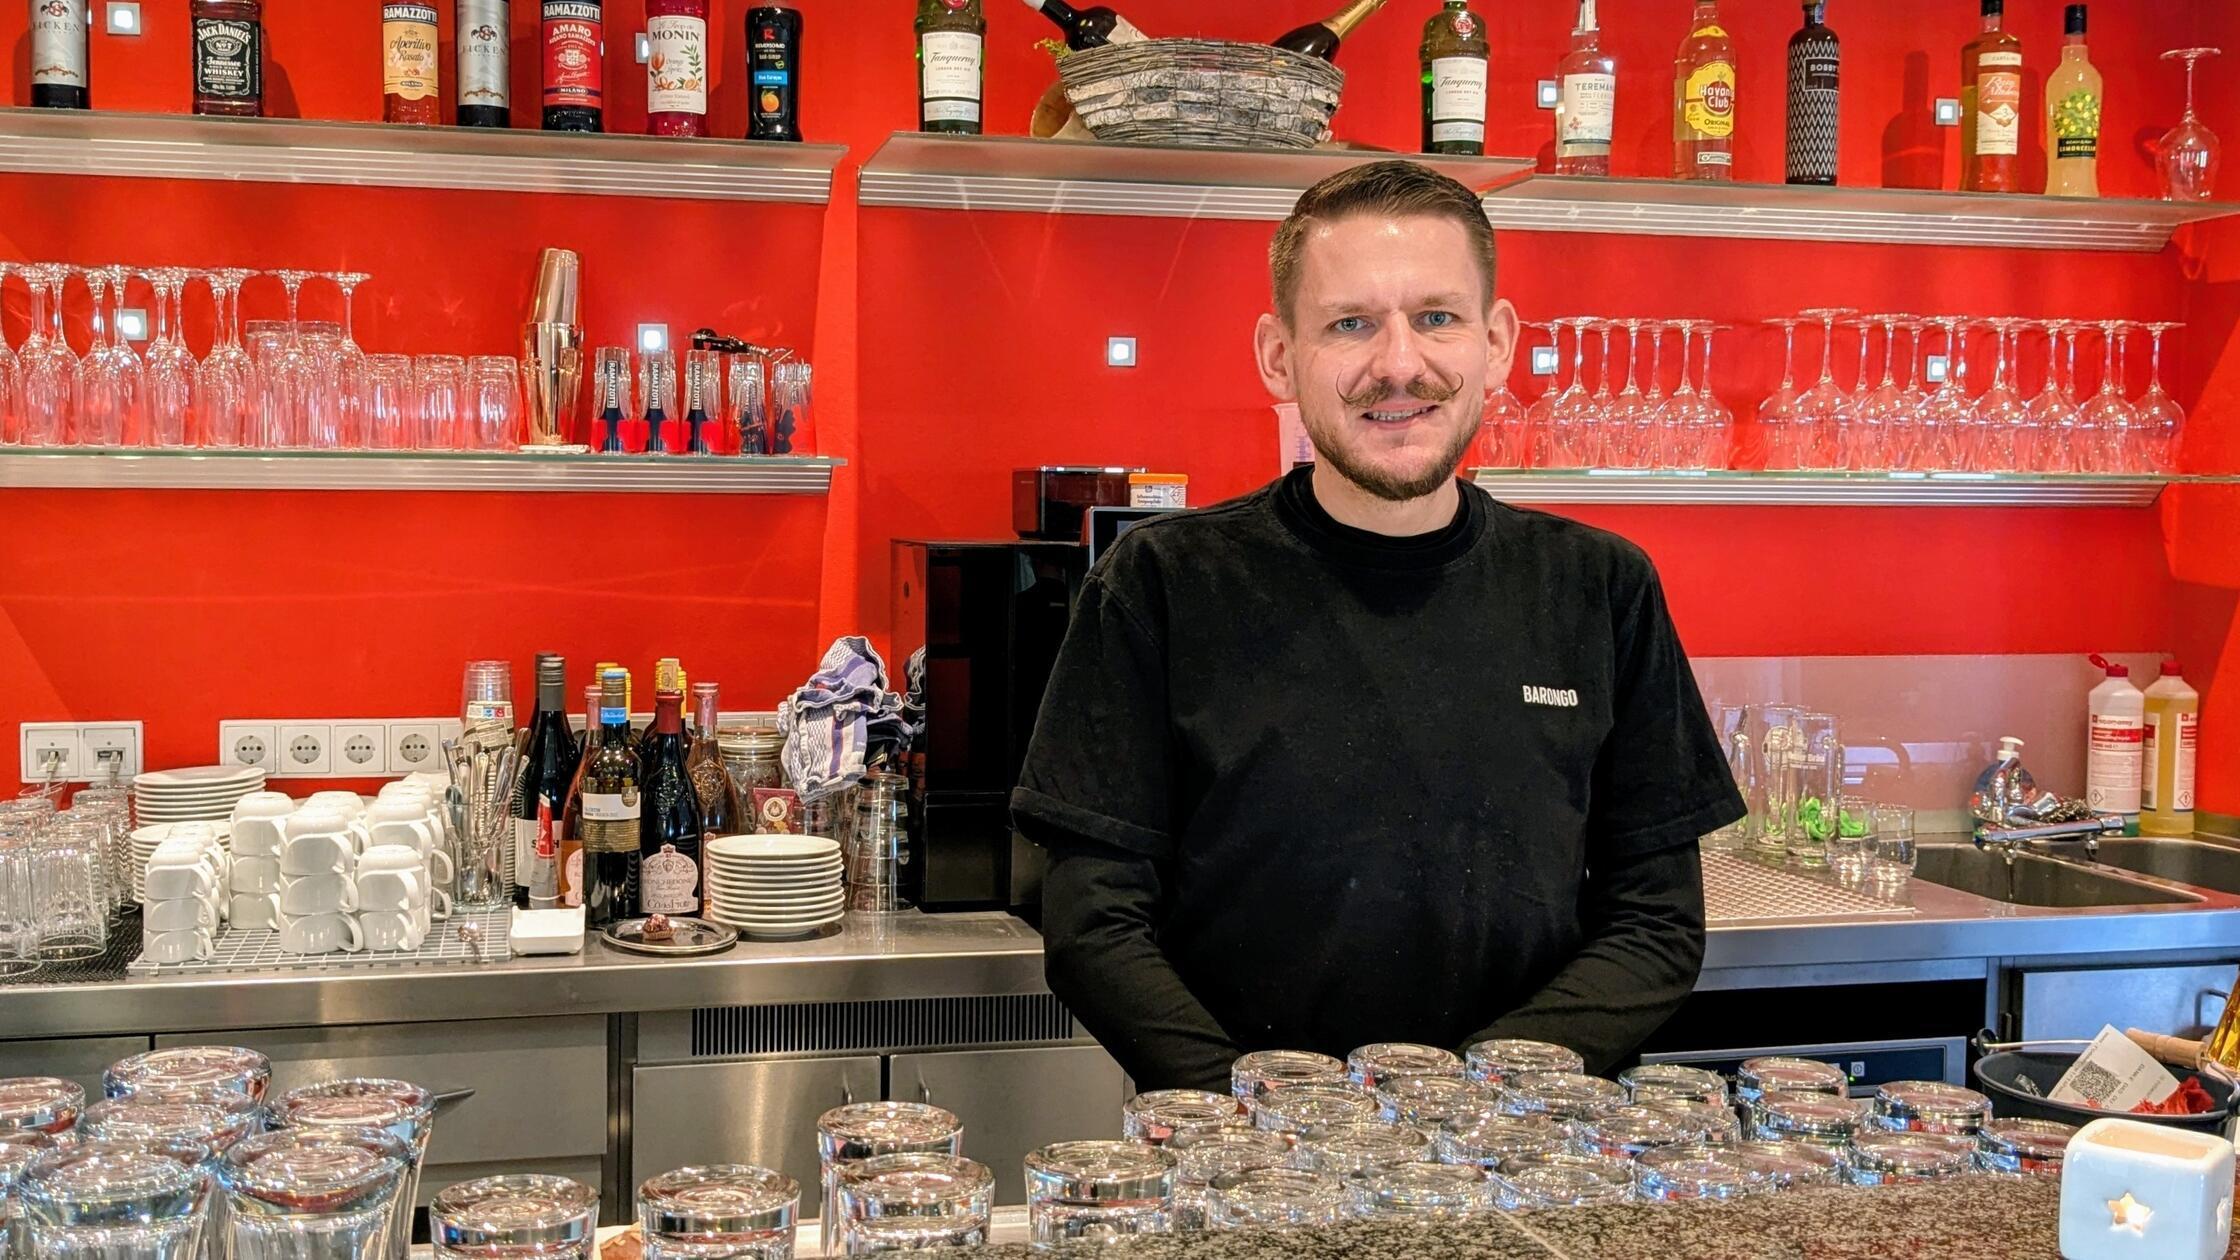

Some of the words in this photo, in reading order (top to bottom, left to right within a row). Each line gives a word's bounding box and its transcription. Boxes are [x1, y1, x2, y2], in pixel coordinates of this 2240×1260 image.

[383, 7, 437, 22] RAMAZZOTTI
[544, 4, 600, 20] RAMAZZOTTI
[197, 25, 218, 41] JACK
[217, 23, 251, 46] DANIEL'S
[553, 24, 592, 37] AMARO
[652, 30, 699, 42] MONIN
[930, 51, 976, 66] Tanqueray
[204, 68, 244, 77] WHISKEY
[1440, 76, 1483, 89] Tanqueray
[1707, 95, 1729, 108] Club
[608, 362, 616, 407] RAMAZZOTTI
[651, 362, 659, 407] RAMAZZOTTI
[693, 364, 701, 408] RAMAZZOTTI
[1522, 685, 1579, 707] BARONGO
